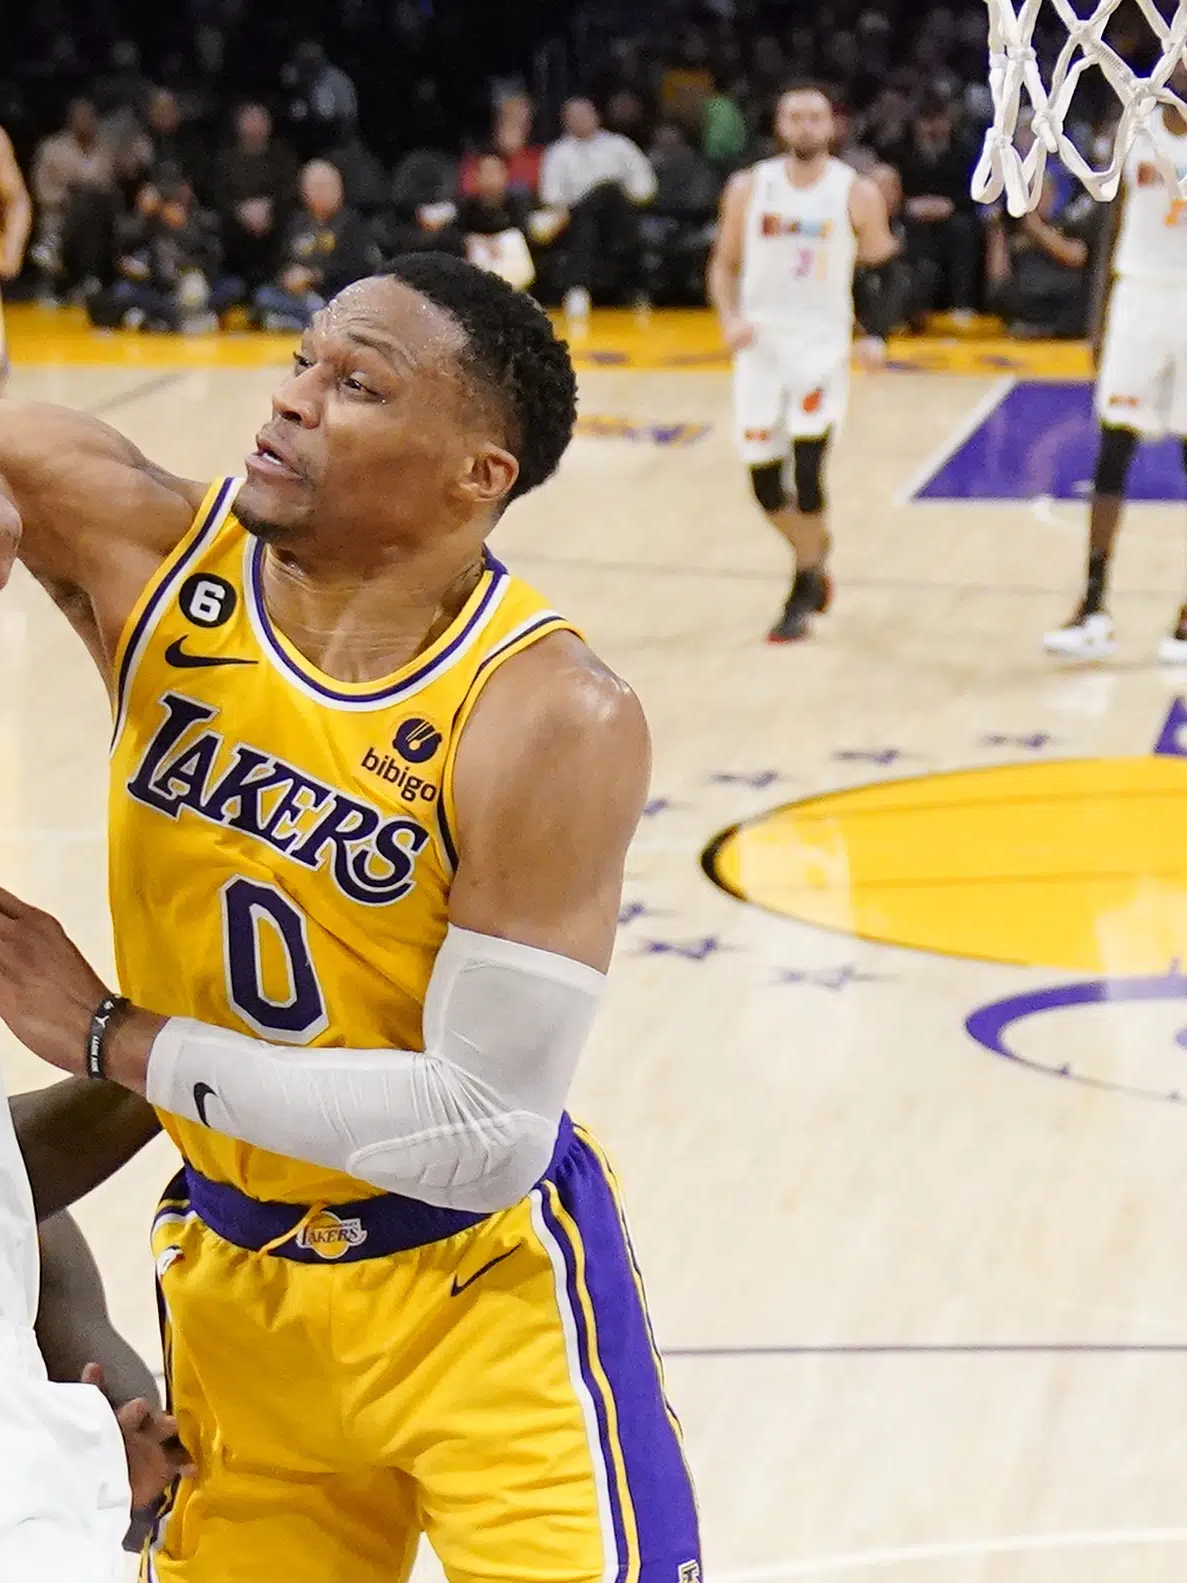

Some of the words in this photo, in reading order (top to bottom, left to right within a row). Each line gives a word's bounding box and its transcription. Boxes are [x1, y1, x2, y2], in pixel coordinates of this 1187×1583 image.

[189, 580, 226, 623] 6
[126, 690, 430, 907] LAKERS
[361, 747, 438, 802] bibigo
[220, 873, 330, 1046] 0
